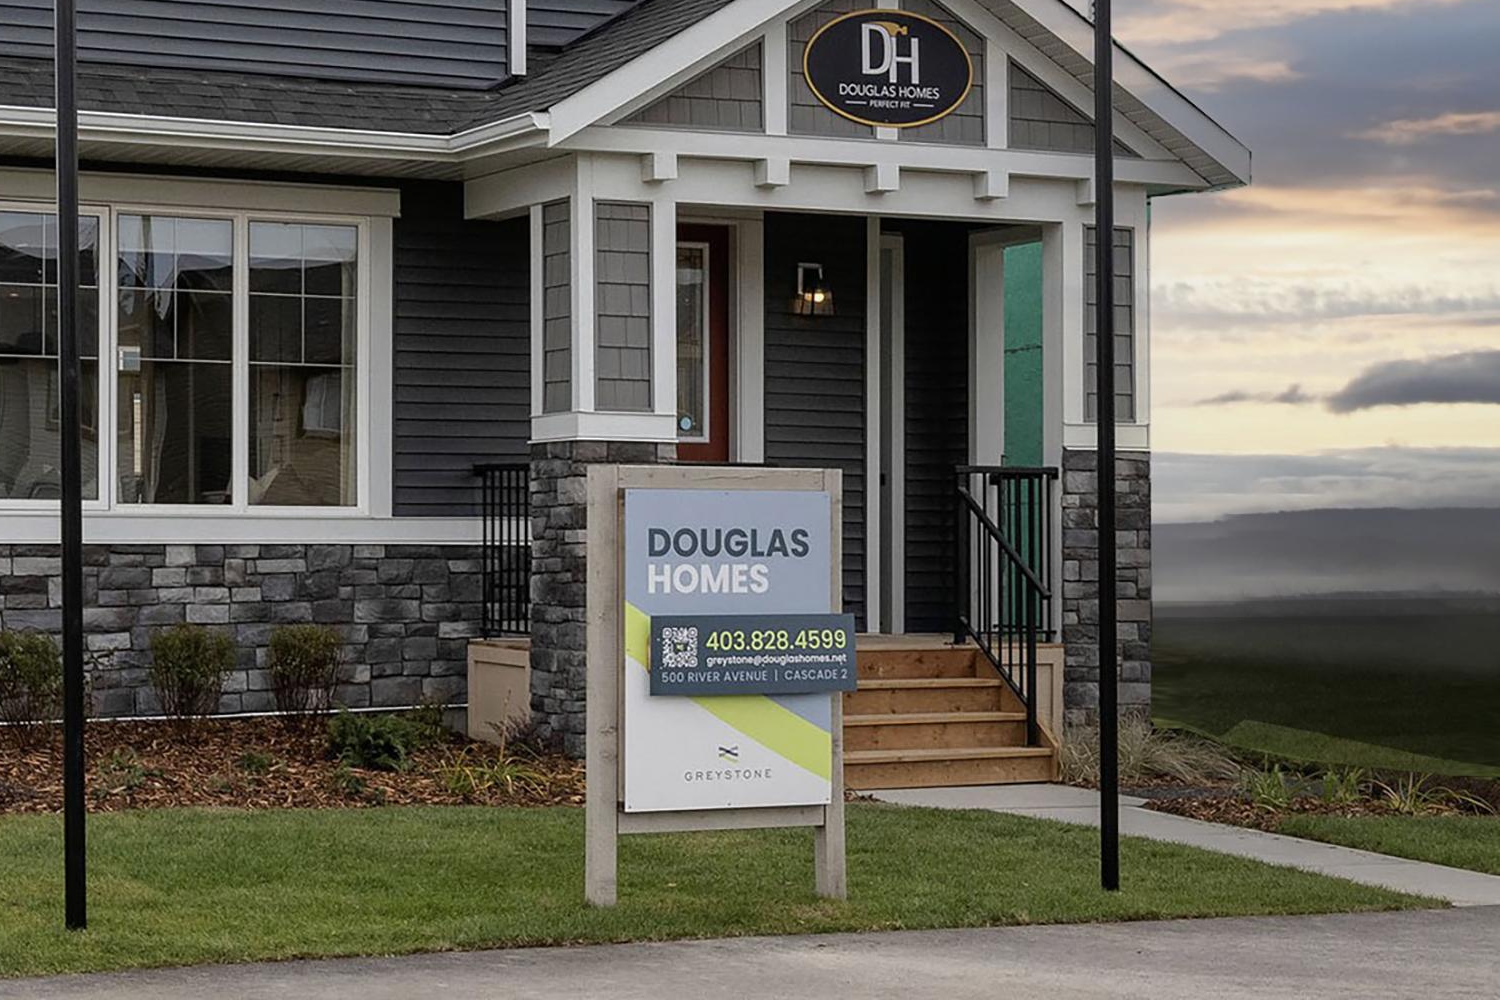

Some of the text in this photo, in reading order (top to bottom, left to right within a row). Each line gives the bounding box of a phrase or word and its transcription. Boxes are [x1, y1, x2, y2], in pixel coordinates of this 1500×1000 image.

[839, 83, 940, 100] DOUGLAS HOMES
[869, 99, 899, 109] PERFECT
[648, 527, 810, 558] DOUGLAS
[647, 563, 770, 594] HOMES
[706, 629, 847, 651] 403.828.4599
[706, 653, 847, 667] greystone@douglashomes.net
[661, 668, 848, 683] 500 RIVER AVENUE CASCADE 2
[684, 768, 772, 782] GREYSTONE
